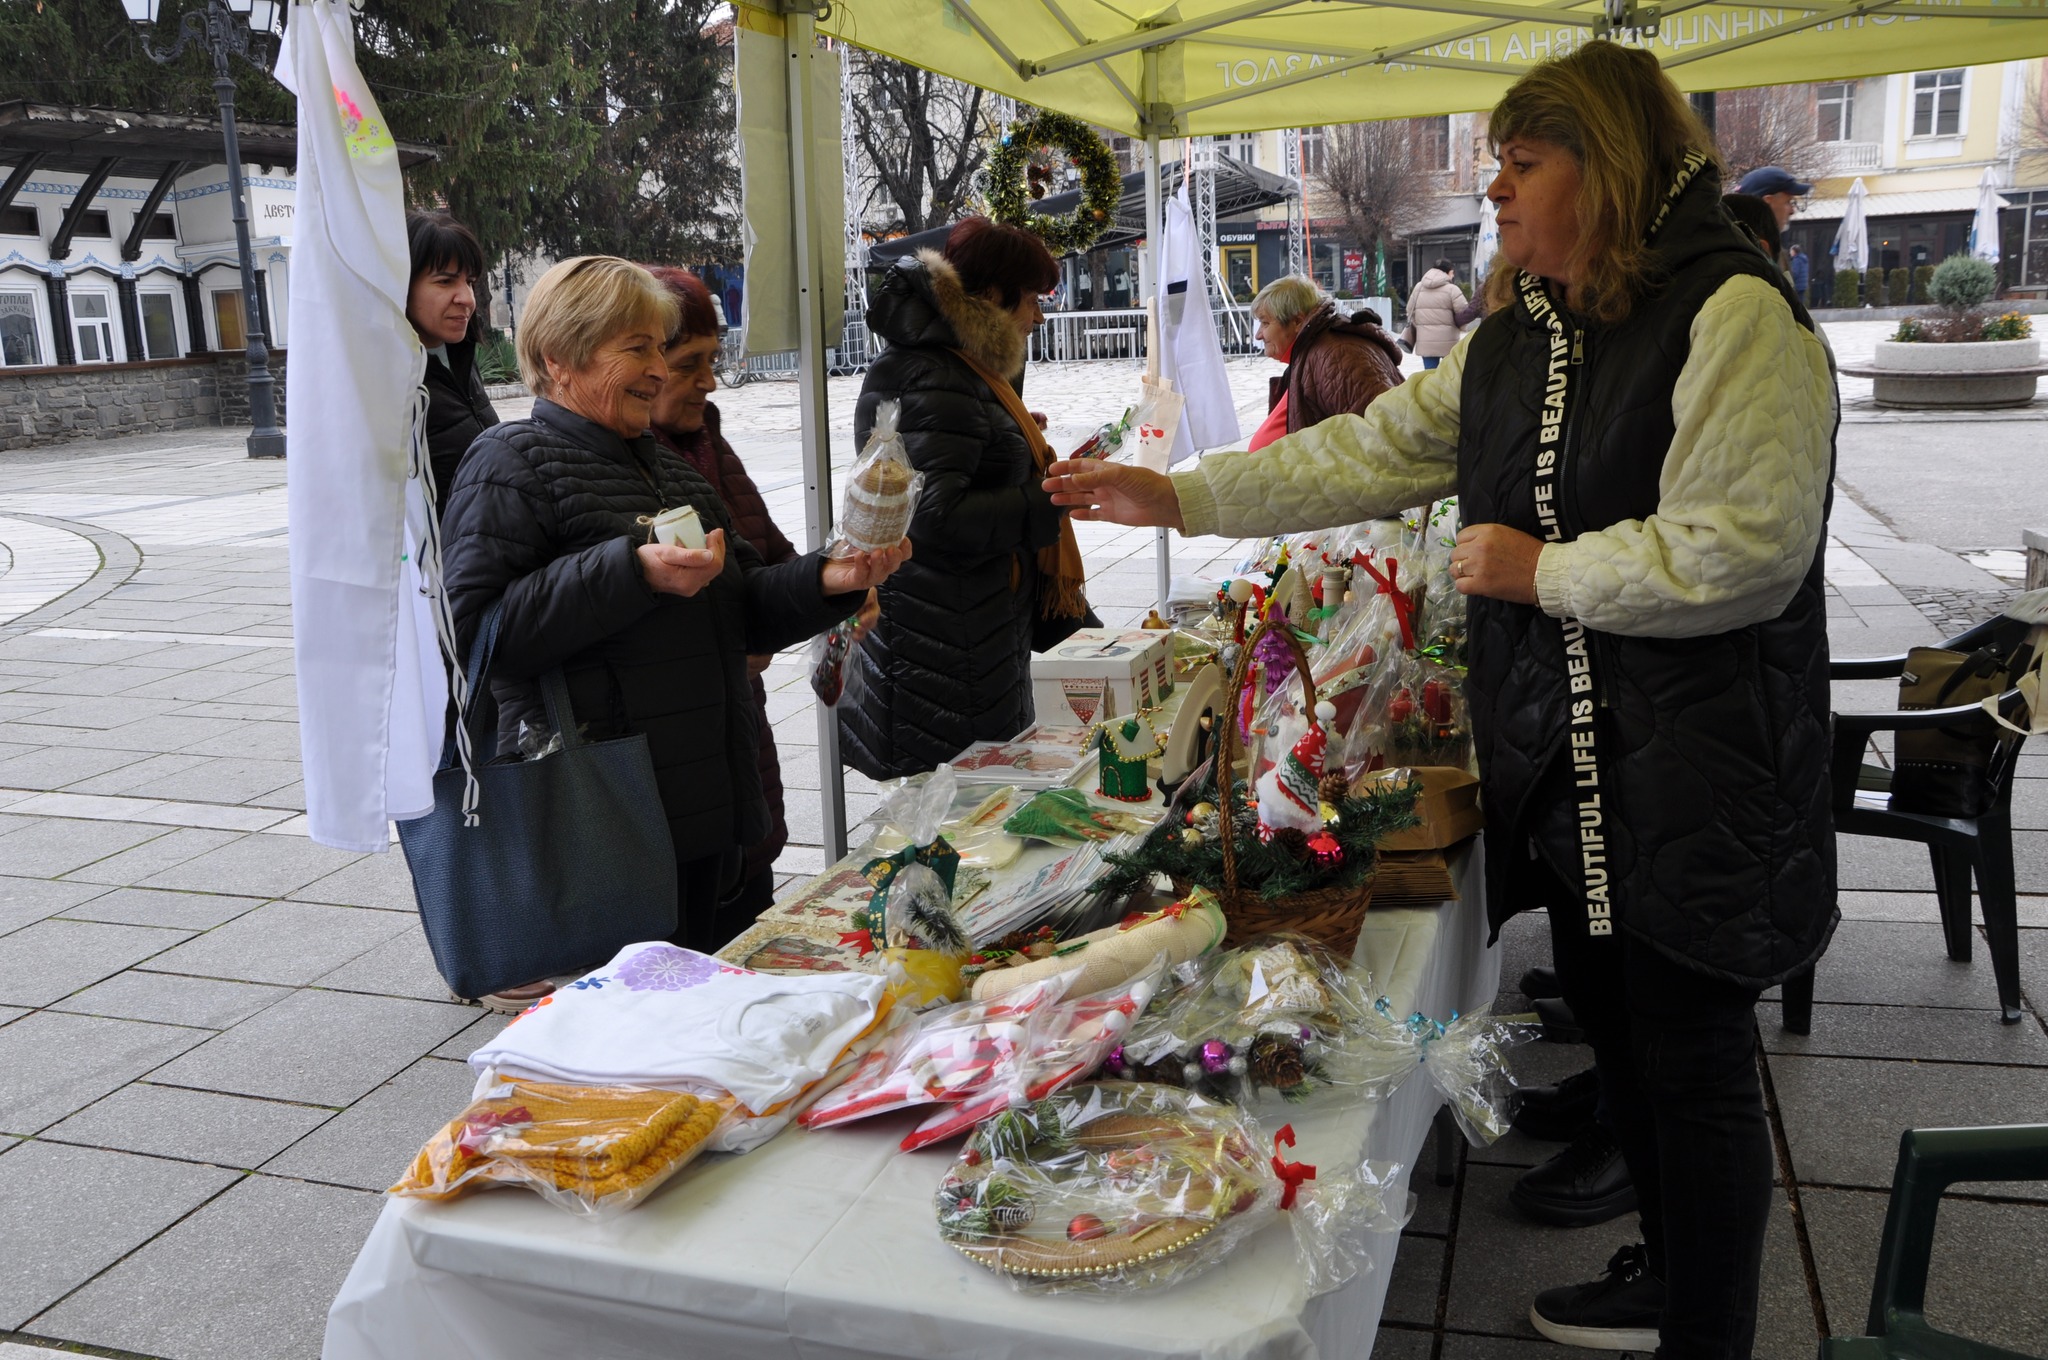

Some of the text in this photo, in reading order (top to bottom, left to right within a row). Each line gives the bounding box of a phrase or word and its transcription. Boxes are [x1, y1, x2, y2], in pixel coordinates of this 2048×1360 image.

[1220, 233, 1255, 243] ОБУВКИ
[1536, 449, 1556, 477] IS
[1535, 483, 1562, 541] LIFE
[1571, 699, 1594, 725] IS
[1571, 731, 1599, 787] LIFE
[1578, 793, 1613, 936] BEAUTIFUL
